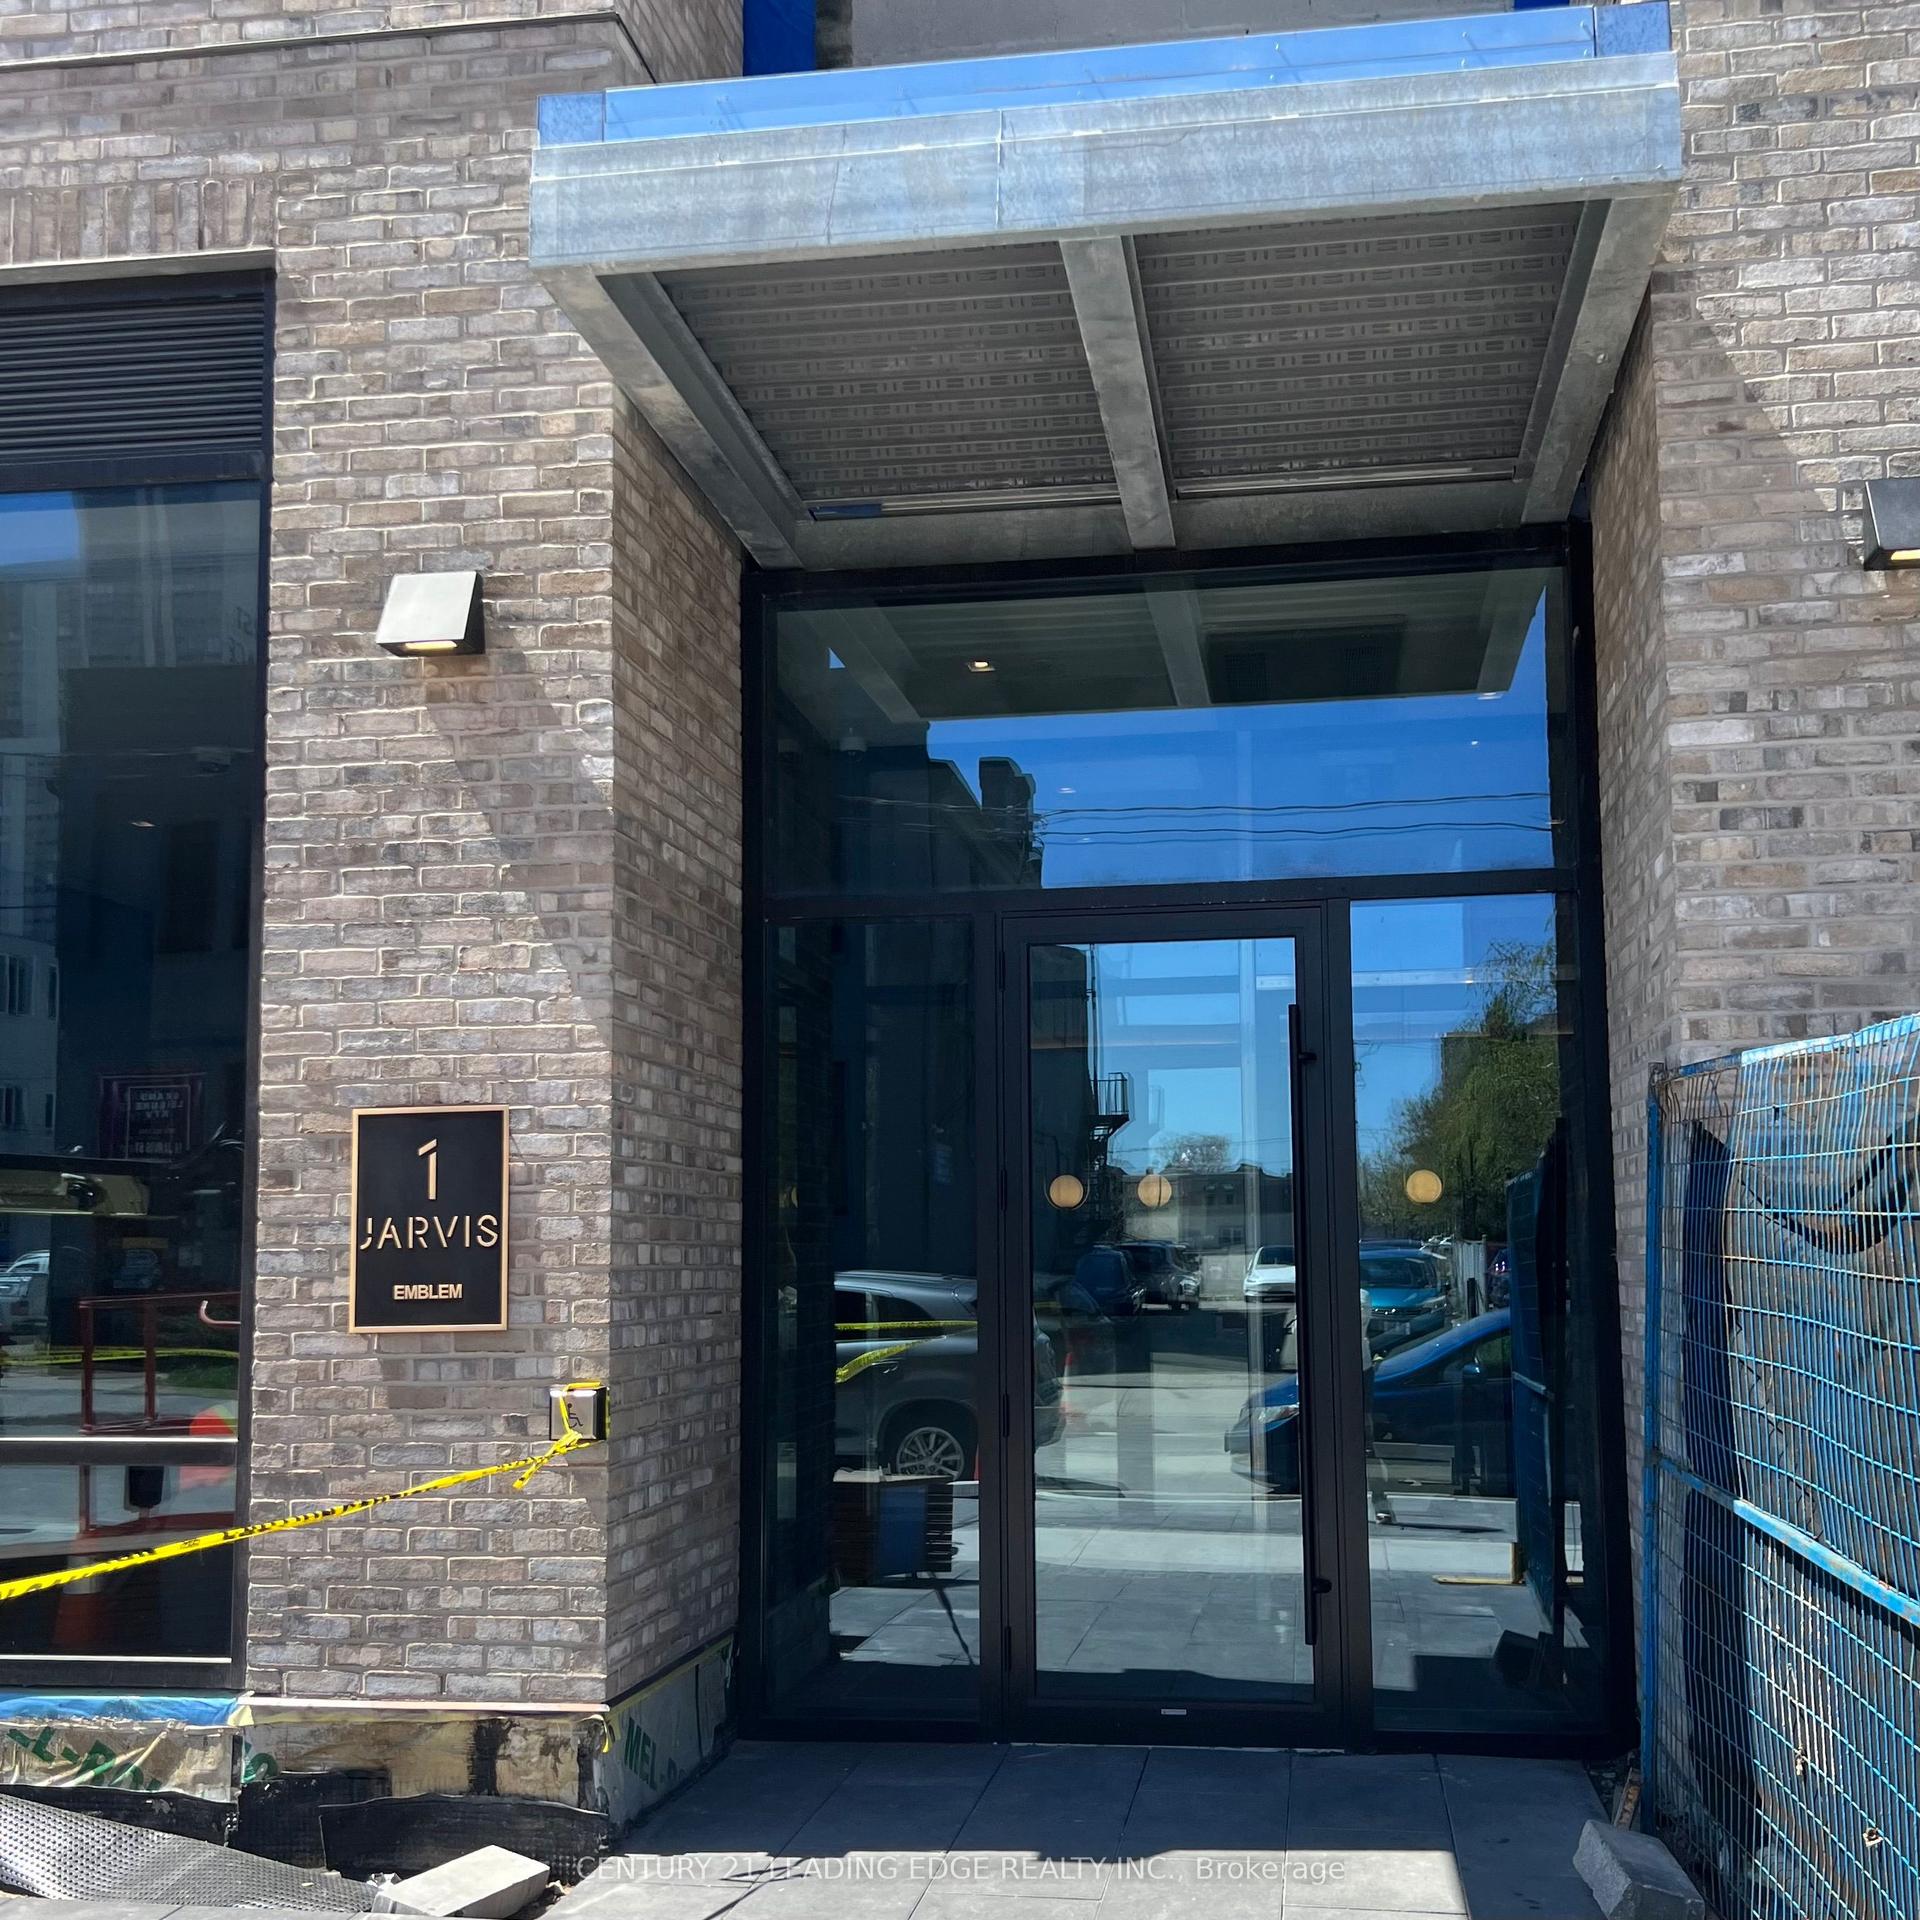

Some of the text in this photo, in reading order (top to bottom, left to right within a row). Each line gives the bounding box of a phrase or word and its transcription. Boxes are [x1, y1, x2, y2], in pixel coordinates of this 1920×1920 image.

[418, 1138, 438, 1201] 1
[360, 1214, 499, 1250] JARVIS
[393, 1283, 463, 1300] EMBLEM
